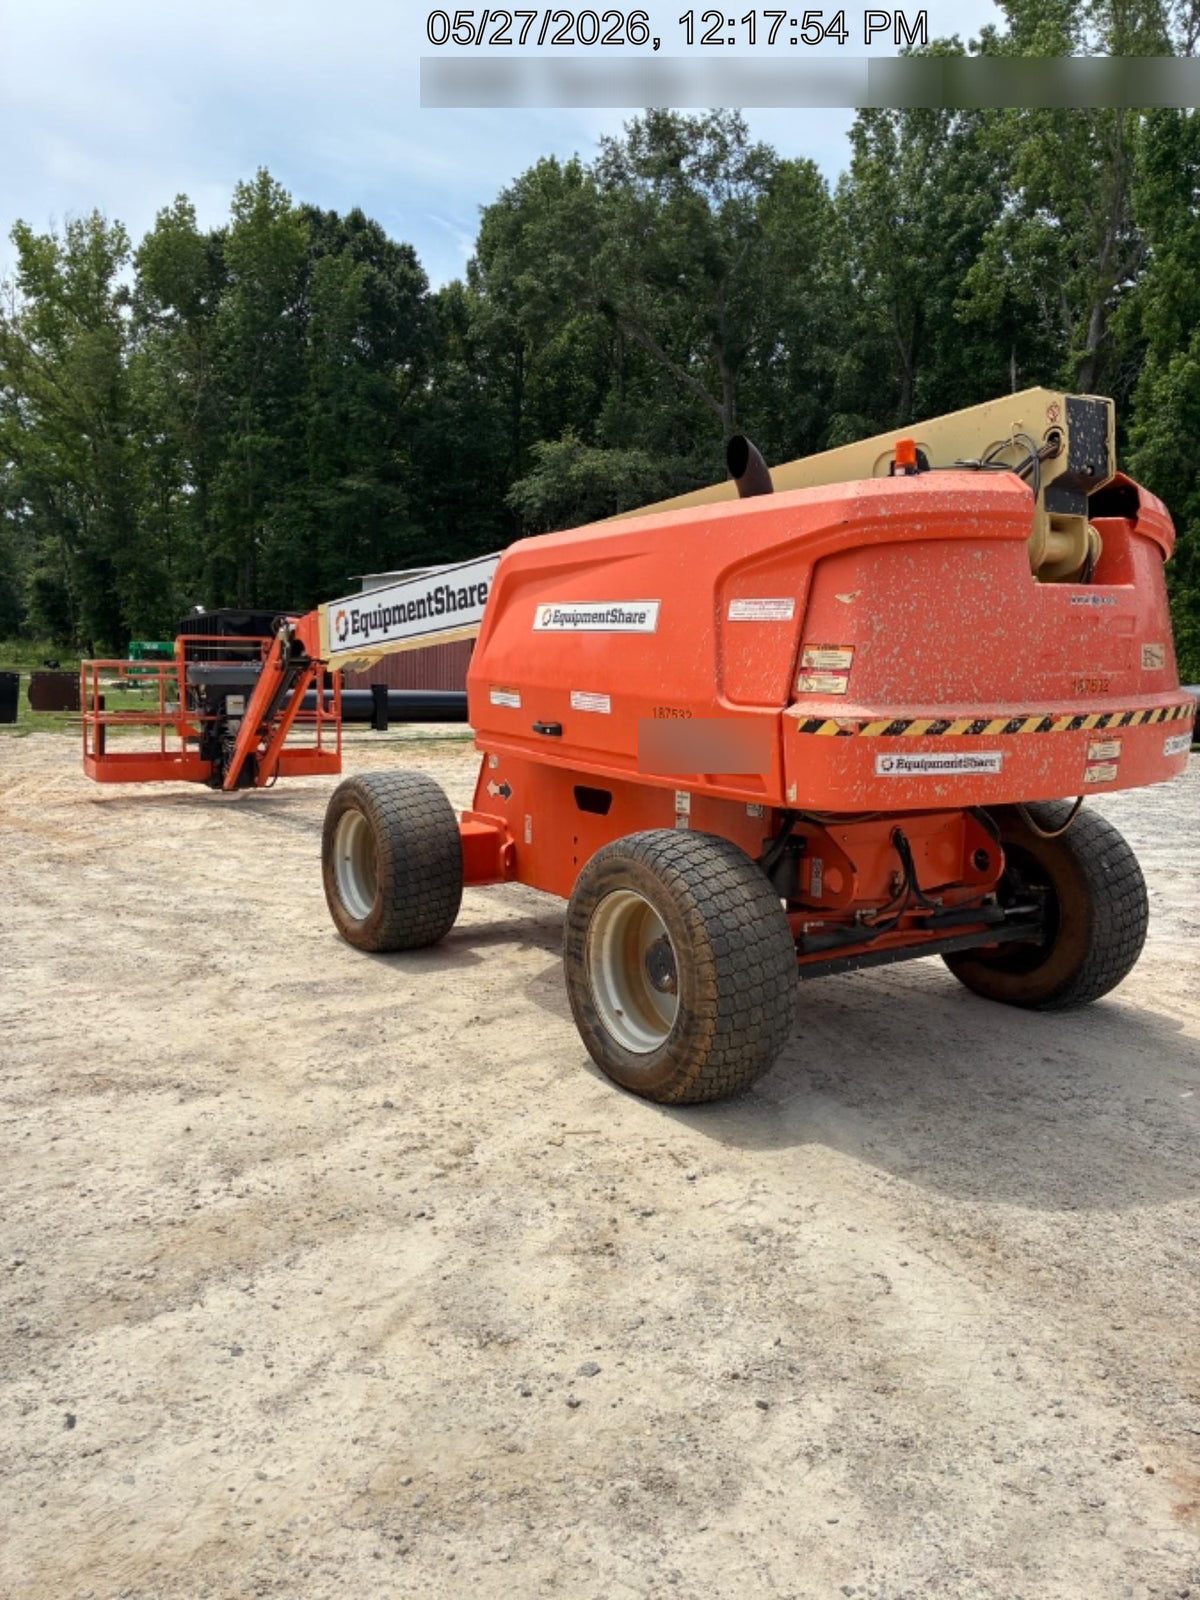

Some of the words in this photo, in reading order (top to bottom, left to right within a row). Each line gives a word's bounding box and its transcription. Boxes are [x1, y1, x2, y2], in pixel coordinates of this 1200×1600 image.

[351, 582, 488, 638] EquipmentShare
[552, 608, 647, 626] EquipmentShare
[895, 758, 996, 771] EquipmentShare
